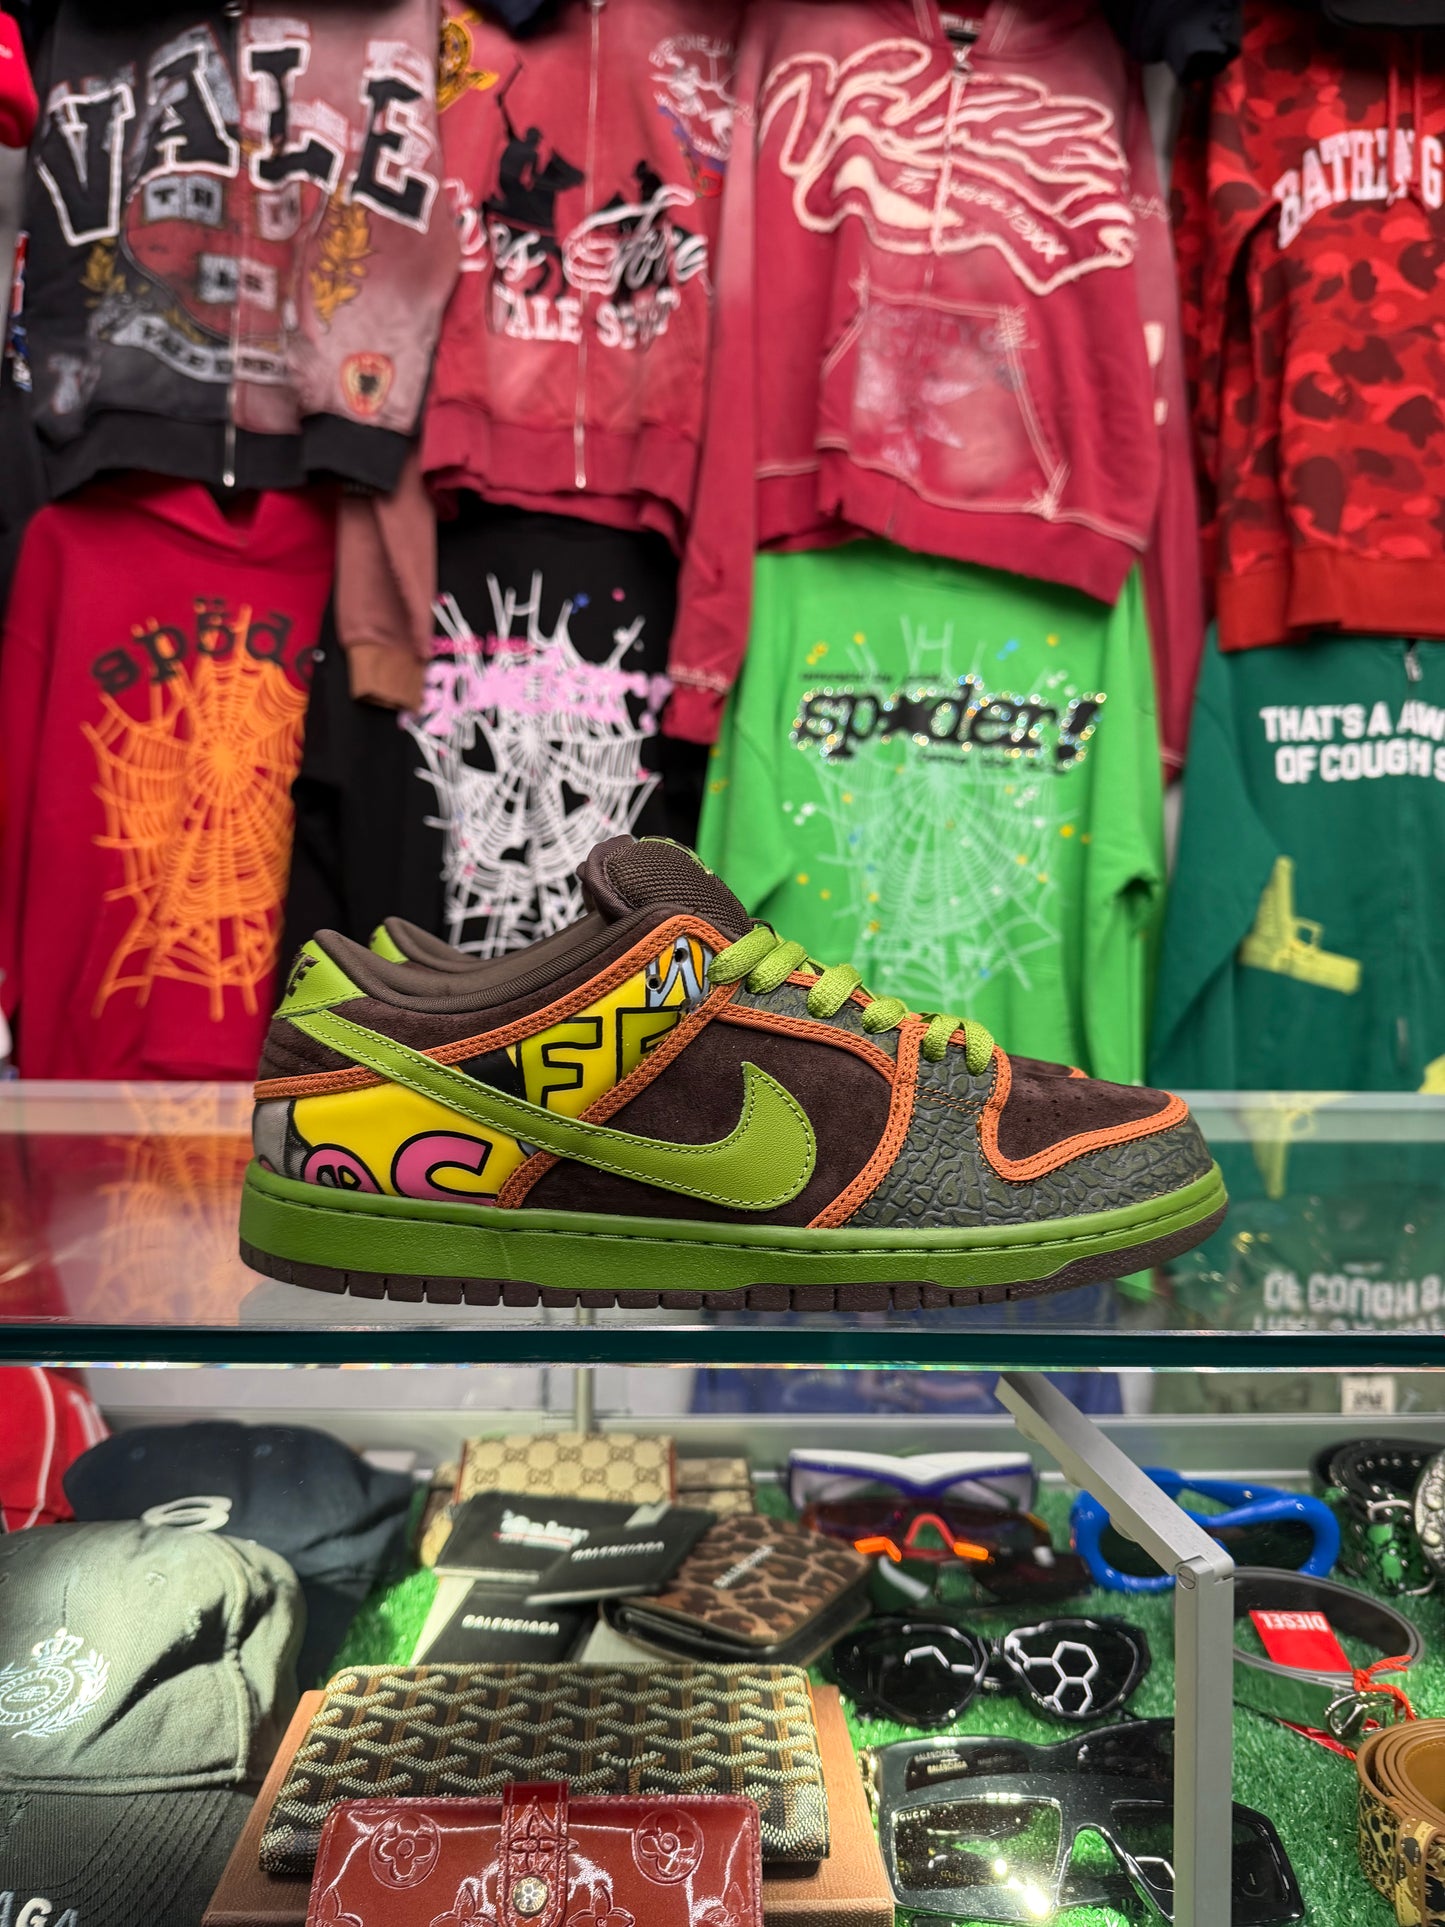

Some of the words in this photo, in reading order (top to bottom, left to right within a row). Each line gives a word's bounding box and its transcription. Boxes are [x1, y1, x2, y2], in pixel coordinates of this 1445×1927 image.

[37, 39, 438, 247] VALE
[1259, 703, 1365, 742] THAT'S
[1367, 701, 1393, 737] A
[1275, 745, 1317, 784] OF
[1319, 738, 1432, 782] COUGH
[1256, 1612, 1328, 1632] DIESEL
[899, 1809, 931, 1821] GUCCI
